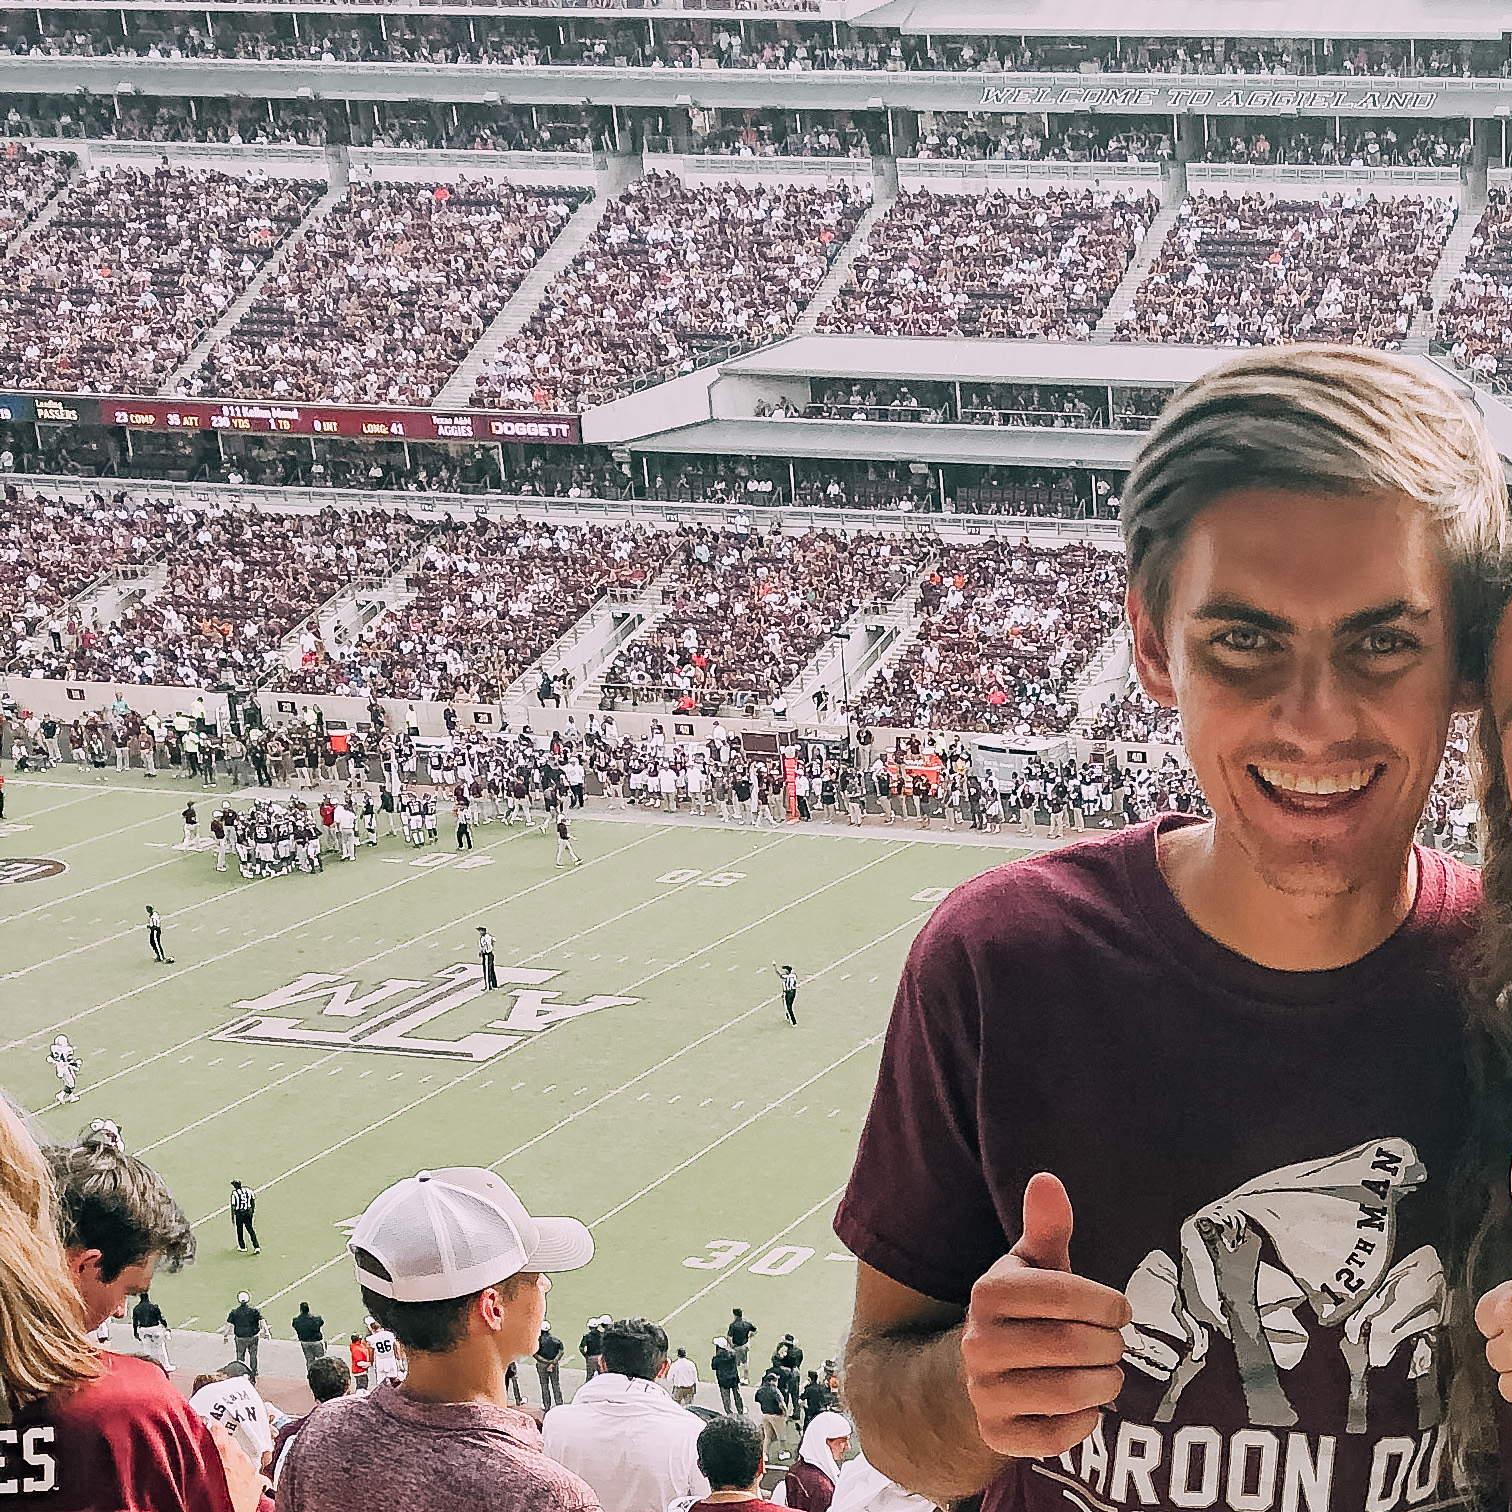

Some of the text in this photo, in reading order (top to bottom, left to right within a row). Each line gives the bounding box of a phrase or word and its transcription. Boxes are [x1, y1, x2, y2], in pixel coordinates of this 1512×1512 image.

[979, 86, 1439, 112] WELCOME TO AGGIELAND
[37, 408, 78, 421] PASSERS
[129, 414, 156, 426] COMP
[183, 416, 200, 427] ATT
[232, 418, 251, 429] YDS
[278, 420, 291, 430] TD
[437, 425, 474, 438] AGGIES
[491, 421, 570, 437] DOGGETT
[1357, 1147, 1403, 1233] MAN
[681, 1238, 816, 1277] 30
[1320, 1239, 1375, 1306] 12TH
[376, 1340, 391, 1354] 86
